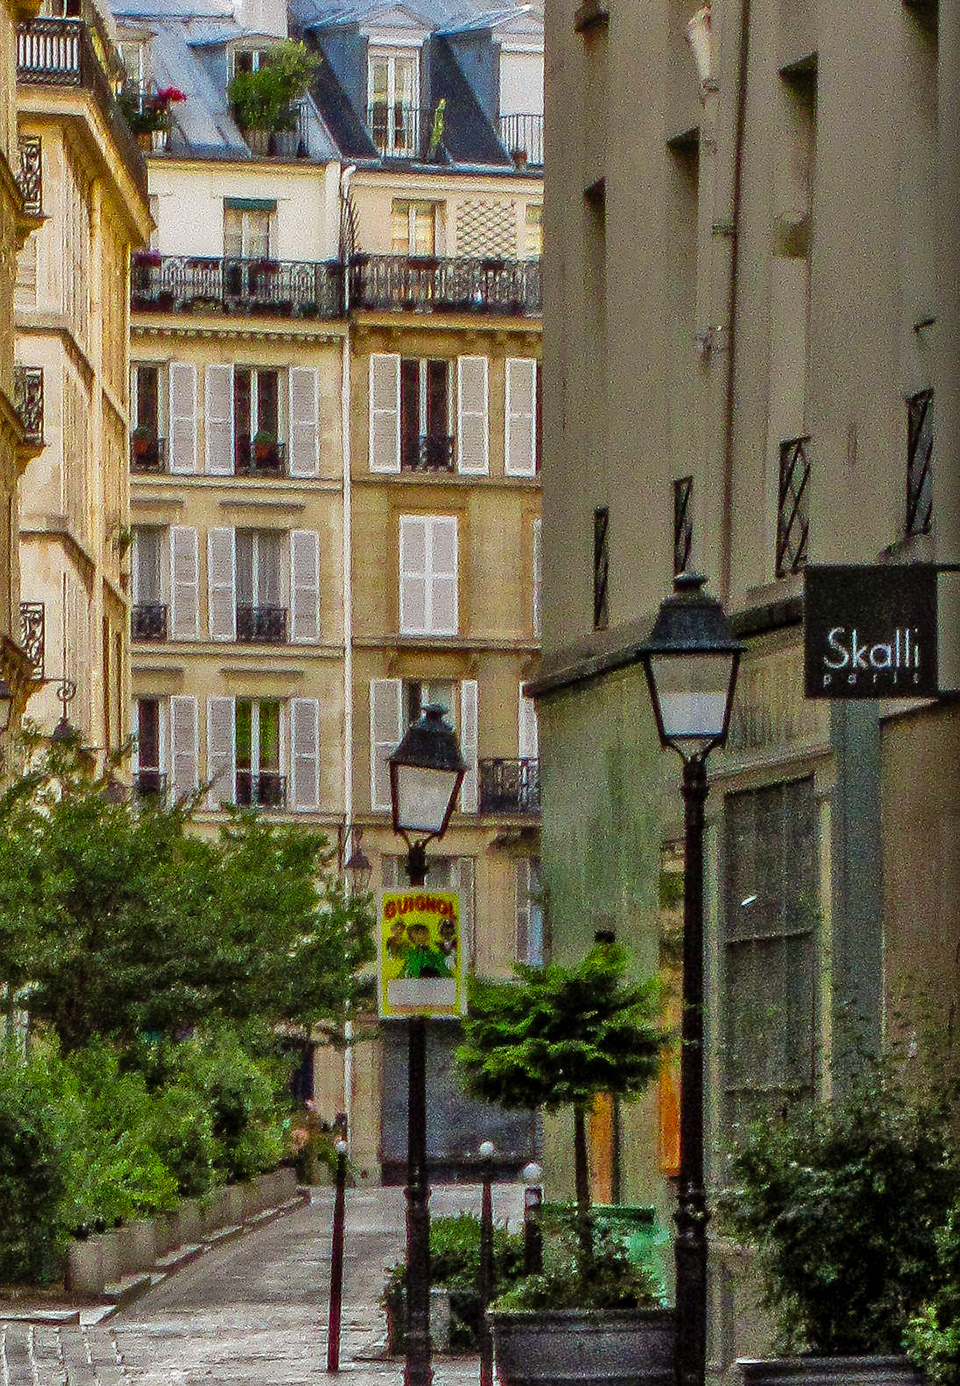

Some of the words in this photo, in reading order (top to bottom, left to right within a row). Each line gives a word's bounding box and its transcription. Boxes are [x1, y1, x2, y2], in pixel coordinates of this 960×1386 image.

[823, 627, 919, 668] Skalli
[823, 673, 919, 687] paris
[384, 894, 456, 919] GUIGNOL
